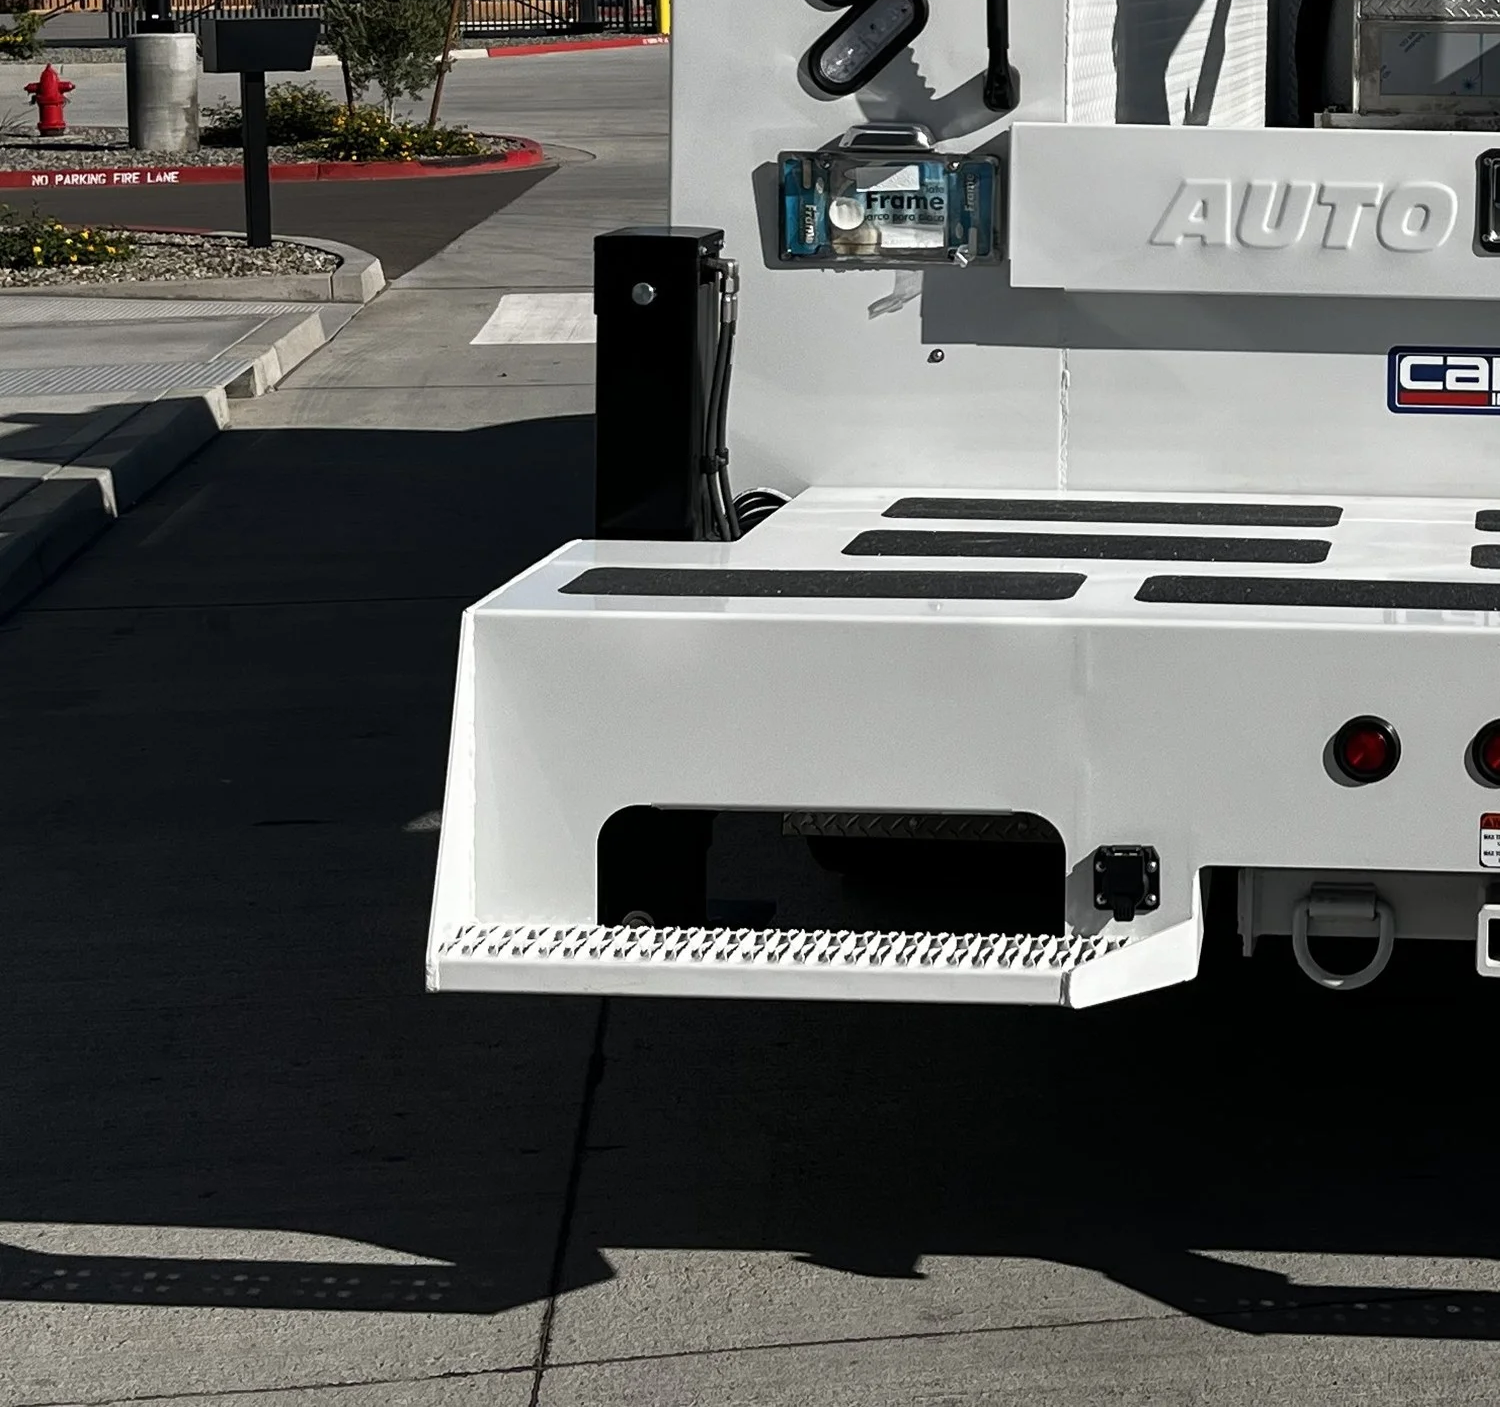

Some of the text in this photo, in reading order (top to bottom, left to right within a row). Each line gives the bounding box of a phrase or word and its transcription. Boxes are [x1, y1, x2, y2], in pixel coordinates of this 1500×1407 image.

[31, 171, 180, 186] NO PARKING FIRE LANE
[866, 193, 945, 211] Frame
[864, 214, 890, 222] arco
[1149, 178, 1458, 253] AUTO
